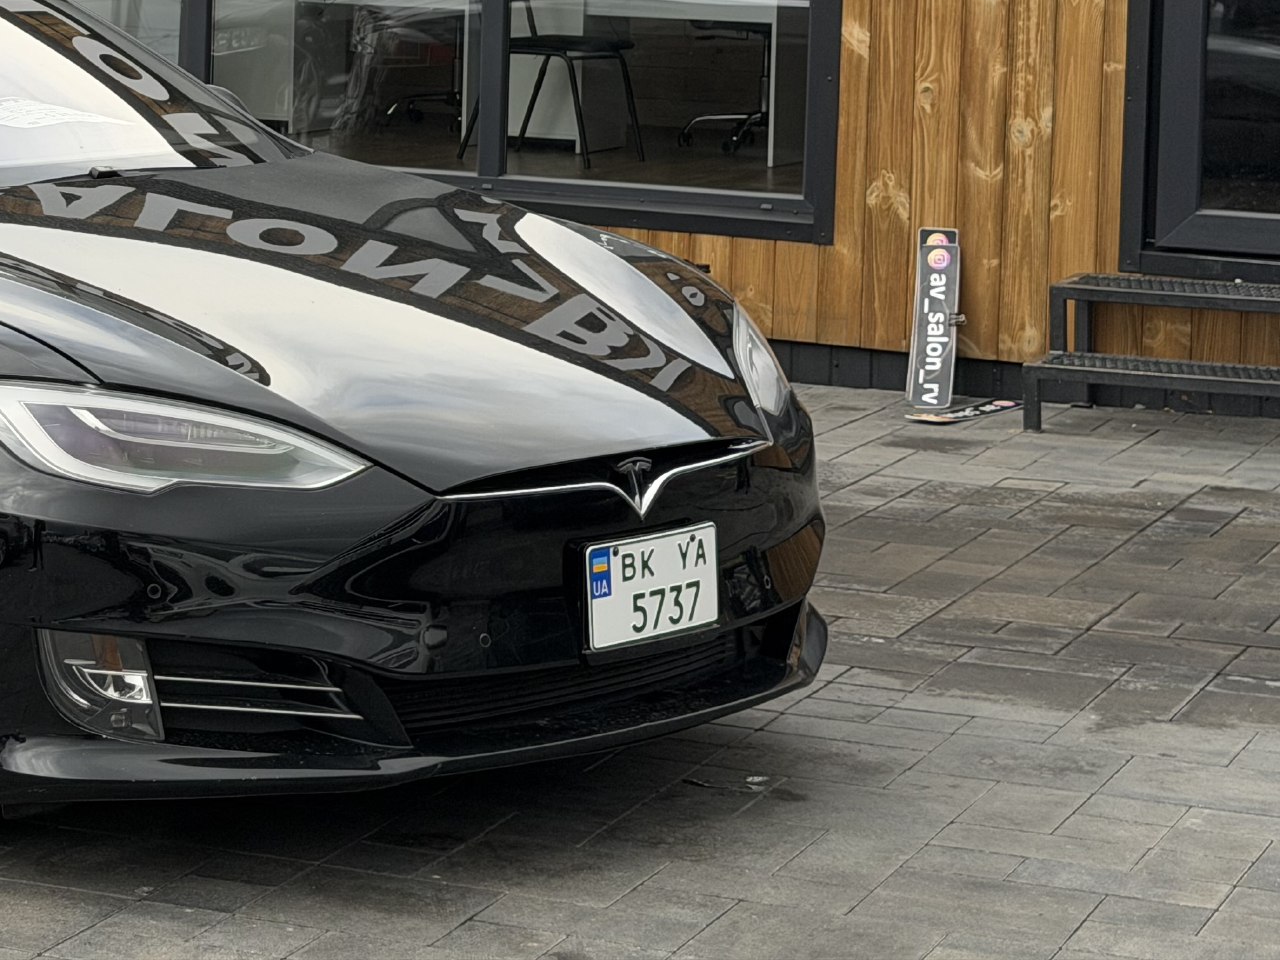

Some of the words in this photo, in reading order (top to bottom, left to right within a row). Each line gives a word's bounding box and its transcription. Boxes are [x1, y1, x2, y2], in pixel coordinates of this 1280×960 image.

[919, 272, 949, 405] av_salon_rv
[621, 548, 655, 583] BK
[677, 537, 707, 570] YA
[593, 580, 609, 597] UA
[631, 579, 701, 634] 5737
